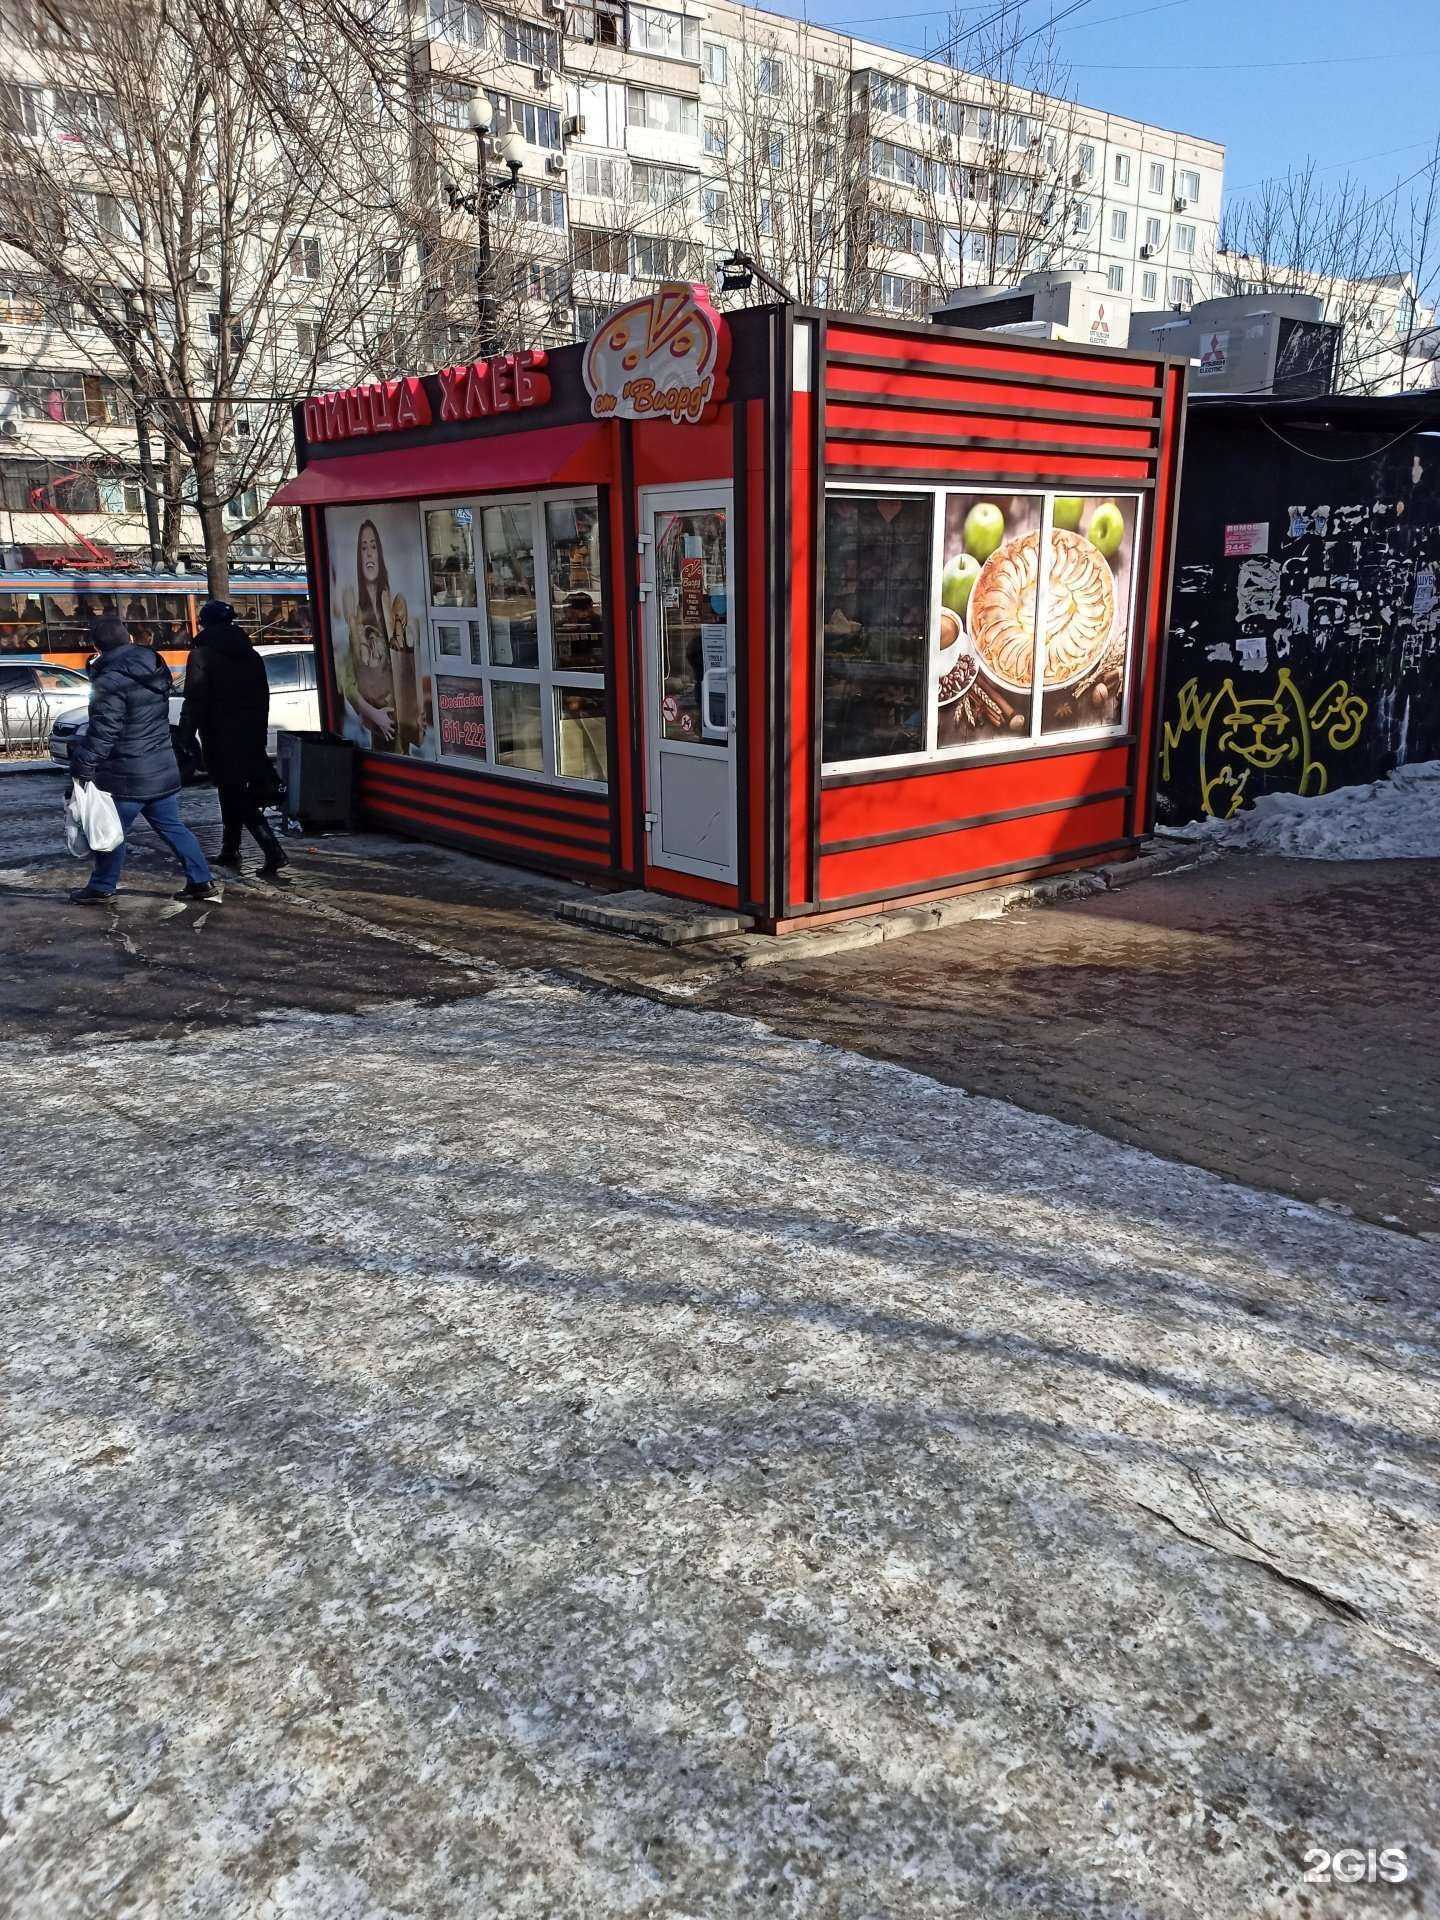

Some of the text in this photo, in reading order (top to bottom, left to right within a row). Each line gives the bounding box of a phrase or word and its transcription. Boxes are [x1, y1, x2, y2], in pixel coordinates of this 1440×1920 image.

[303, 350, 550, 443] ПИЦЦА ХЛЕБ
[594, 394, 617, 413] от
[440, 693, 484, 709] Доставка
[442, 718, 487, 748] 611-222
